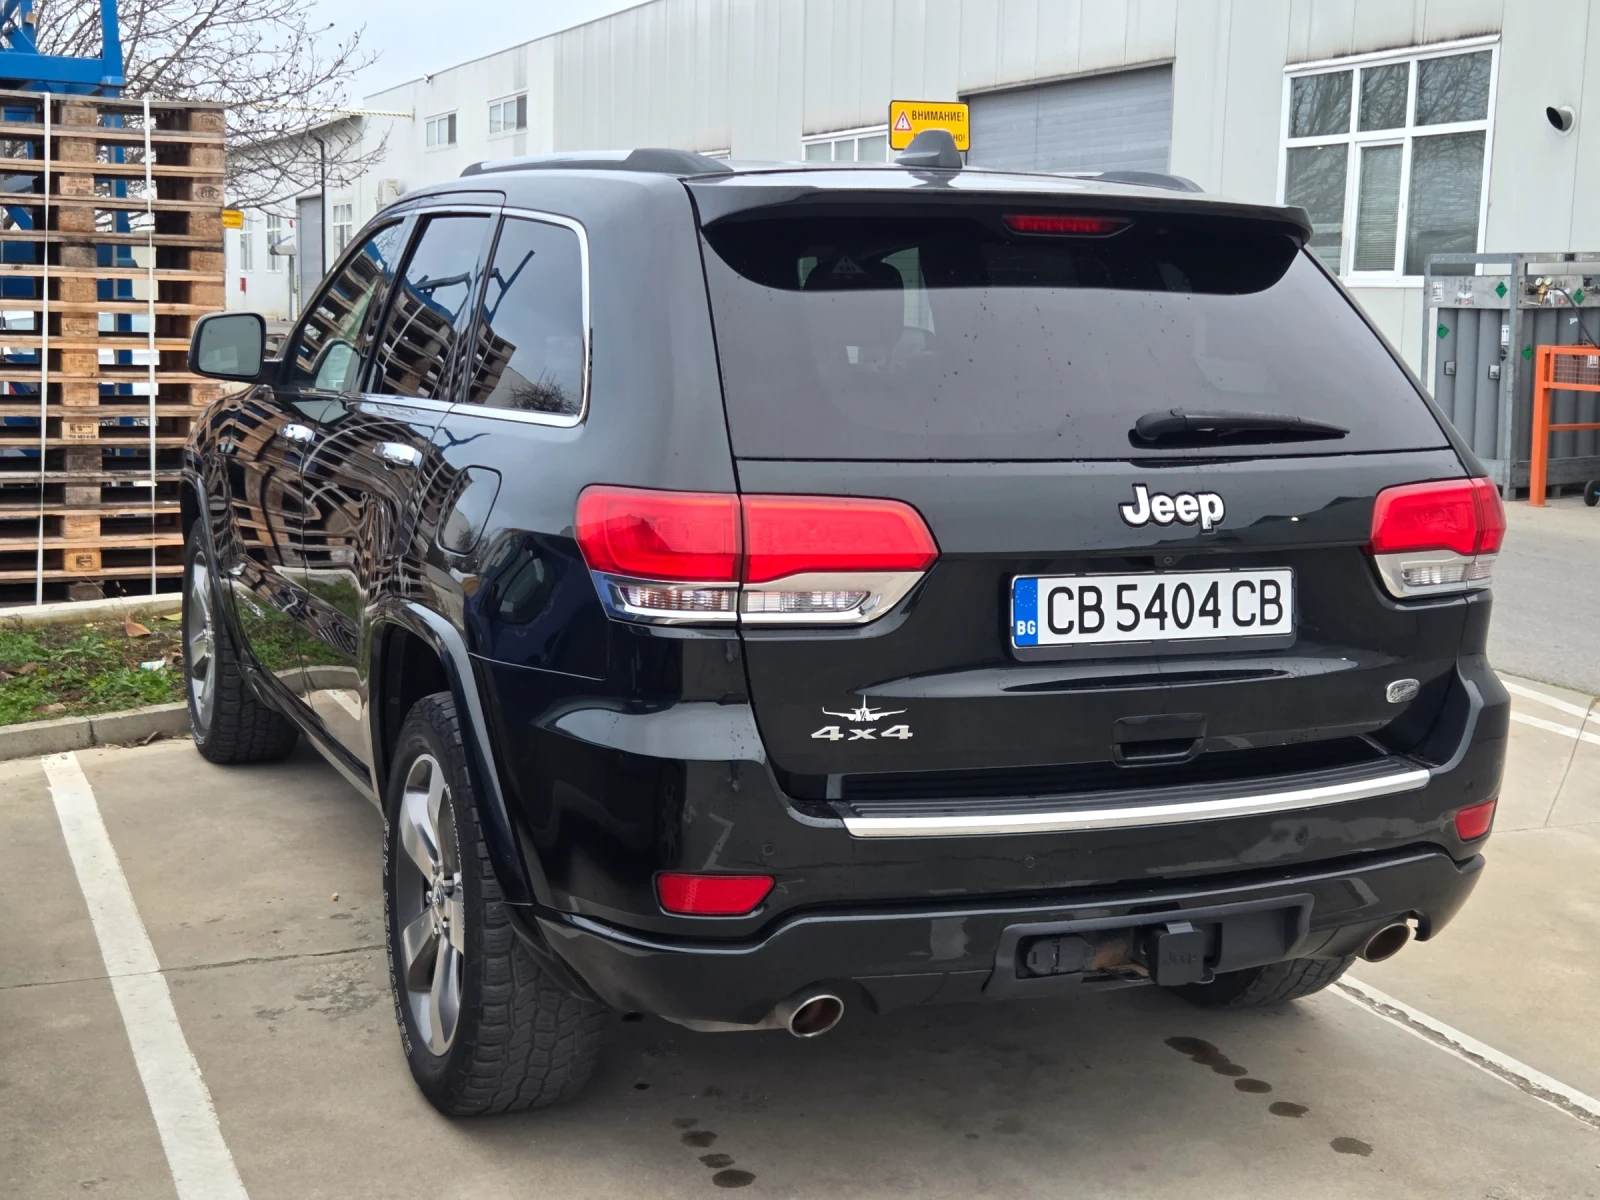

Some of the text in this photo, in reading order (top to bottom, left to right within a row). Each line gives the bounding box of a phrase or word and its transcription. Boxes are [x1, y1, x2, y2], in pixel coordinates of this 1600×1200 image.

[911, 110, 965, 122] ВНИМАНИЕ!
[1118, 483, 1226, 533] Jeep
[1047, 579, 1283, 635] CB 5404 CB
[1016, 620, 1037, 636] BG
